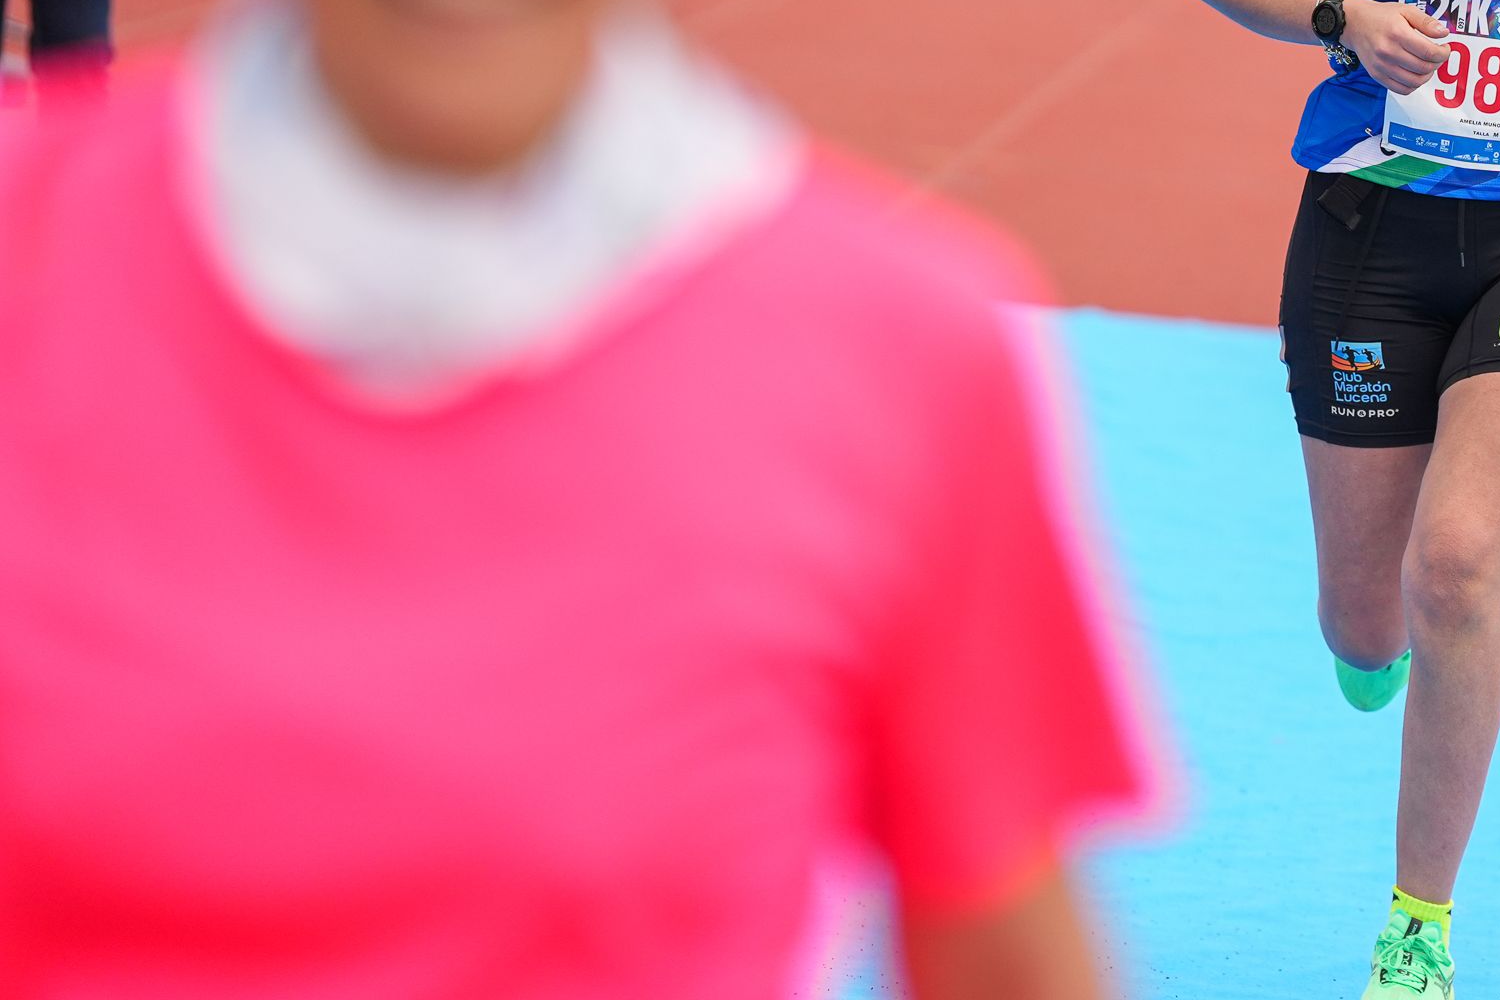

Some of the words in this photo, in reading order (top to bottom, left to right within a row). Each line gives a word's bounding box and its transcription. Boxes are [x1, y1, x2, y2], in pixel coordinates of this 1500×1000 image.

[1459, 118, 1481, 126] AMELIA
[1332, 371, 1363, 383] Club
[1334, 380, 1392, 393] Maratón
[1335, 391, 1388, 403] Lucena
